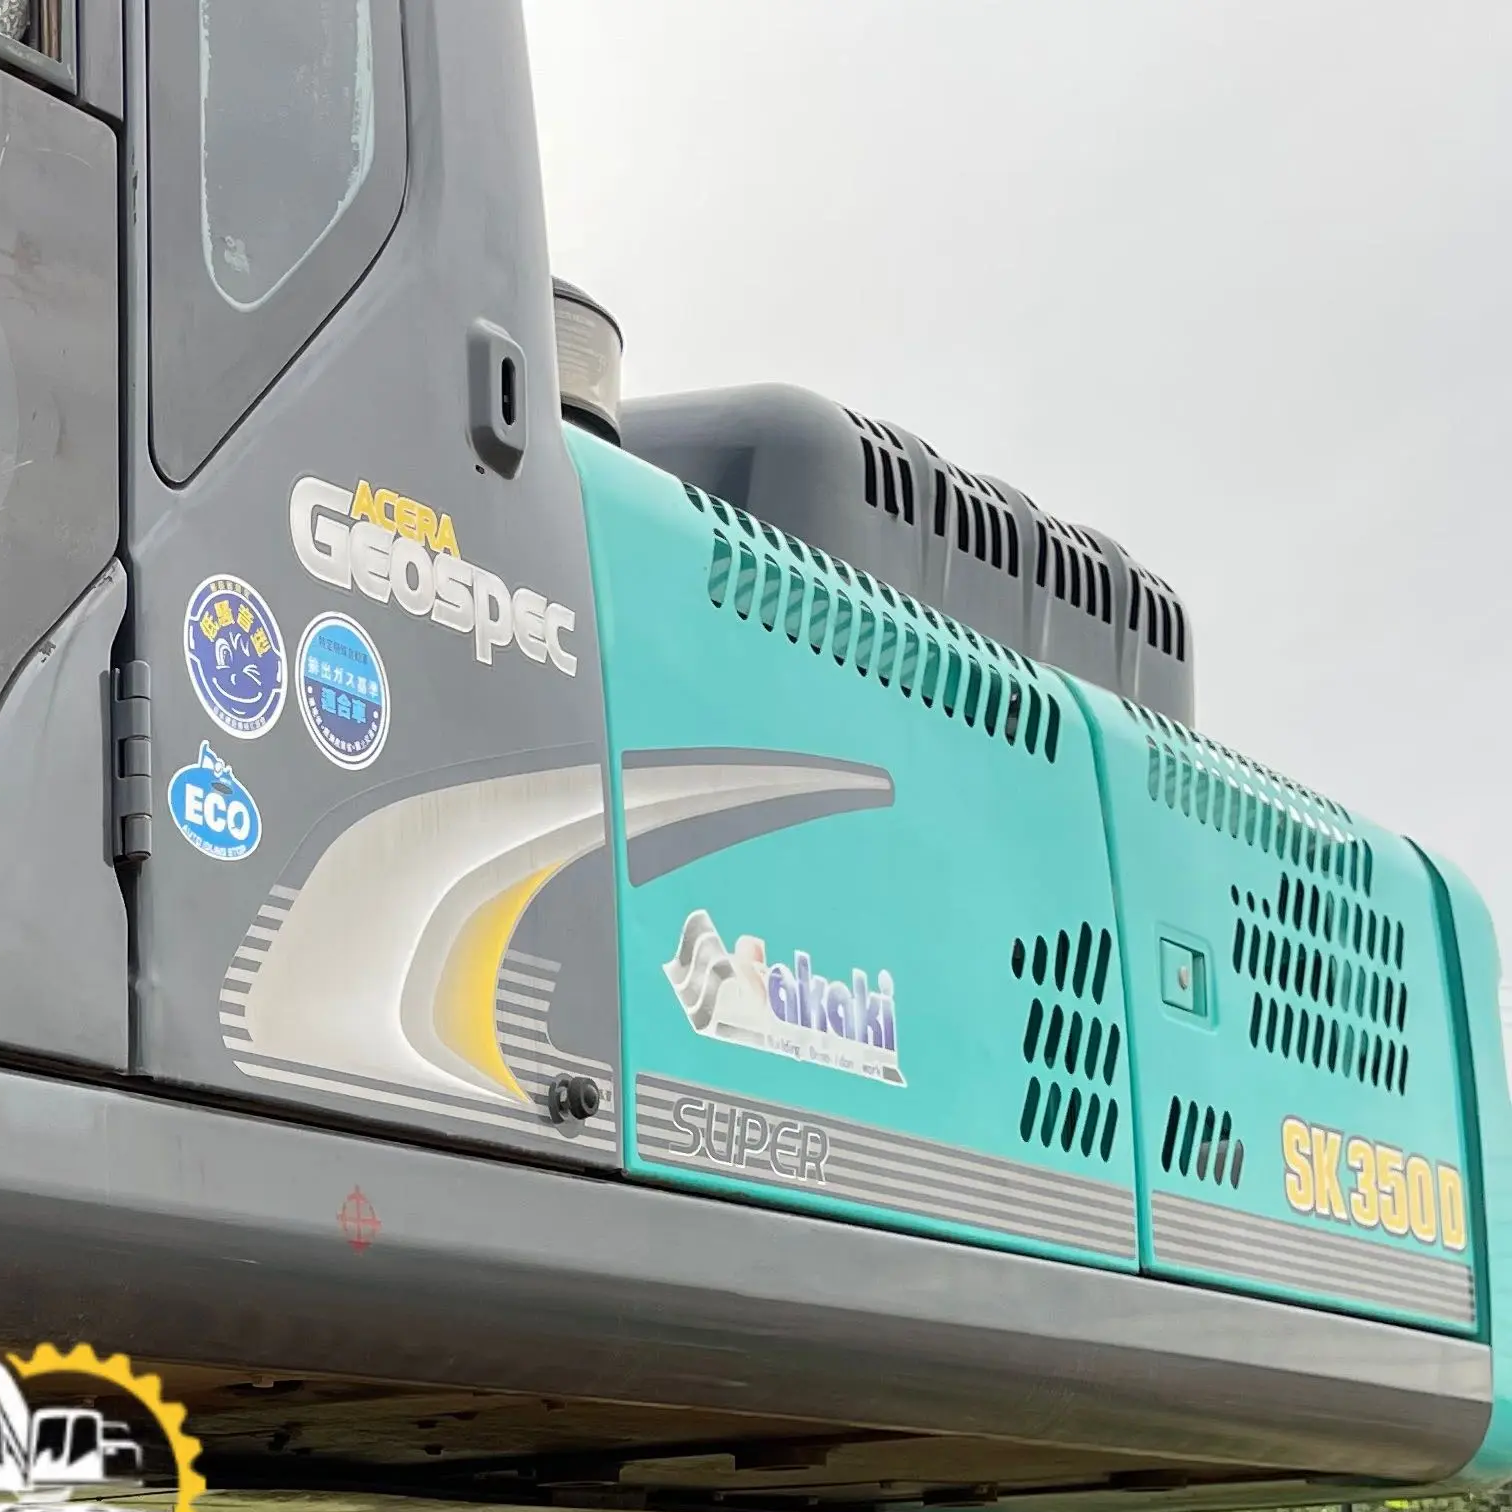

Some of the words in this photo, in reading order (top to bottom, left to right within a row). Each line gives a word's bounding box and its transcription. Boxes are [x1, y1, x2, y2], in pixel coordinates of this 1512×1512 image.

[350, 479, 460, 558] ACERA
[185, 783, 251, 841] ECO
[668, 1097, 829, 1185] SUPER
